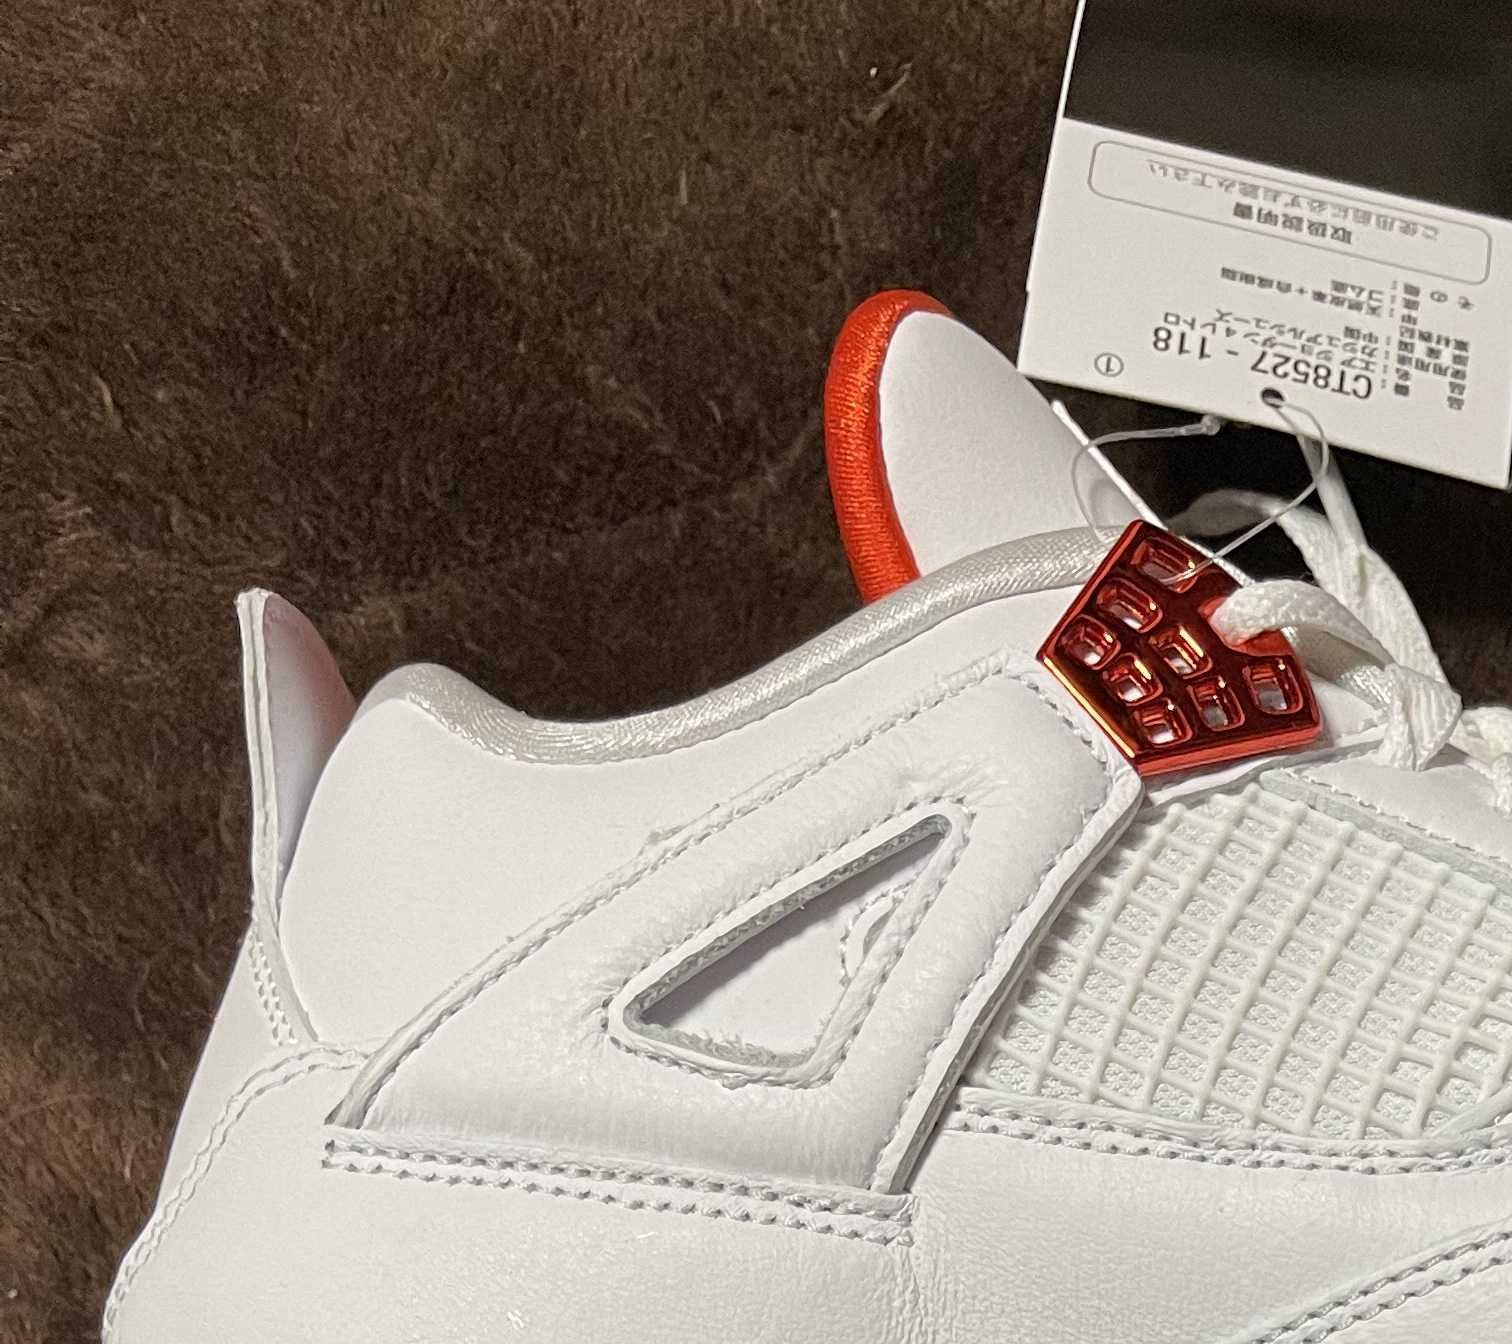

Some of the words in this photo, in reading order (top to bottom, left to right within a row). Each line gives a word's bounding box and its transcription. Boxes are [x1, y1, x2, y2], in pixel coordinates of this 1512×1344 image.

[1164, 312, 1216, 335] レトロ
[1153, 327, 1210, 359] 118
[1251, 350, 1372, 398] CT8527
